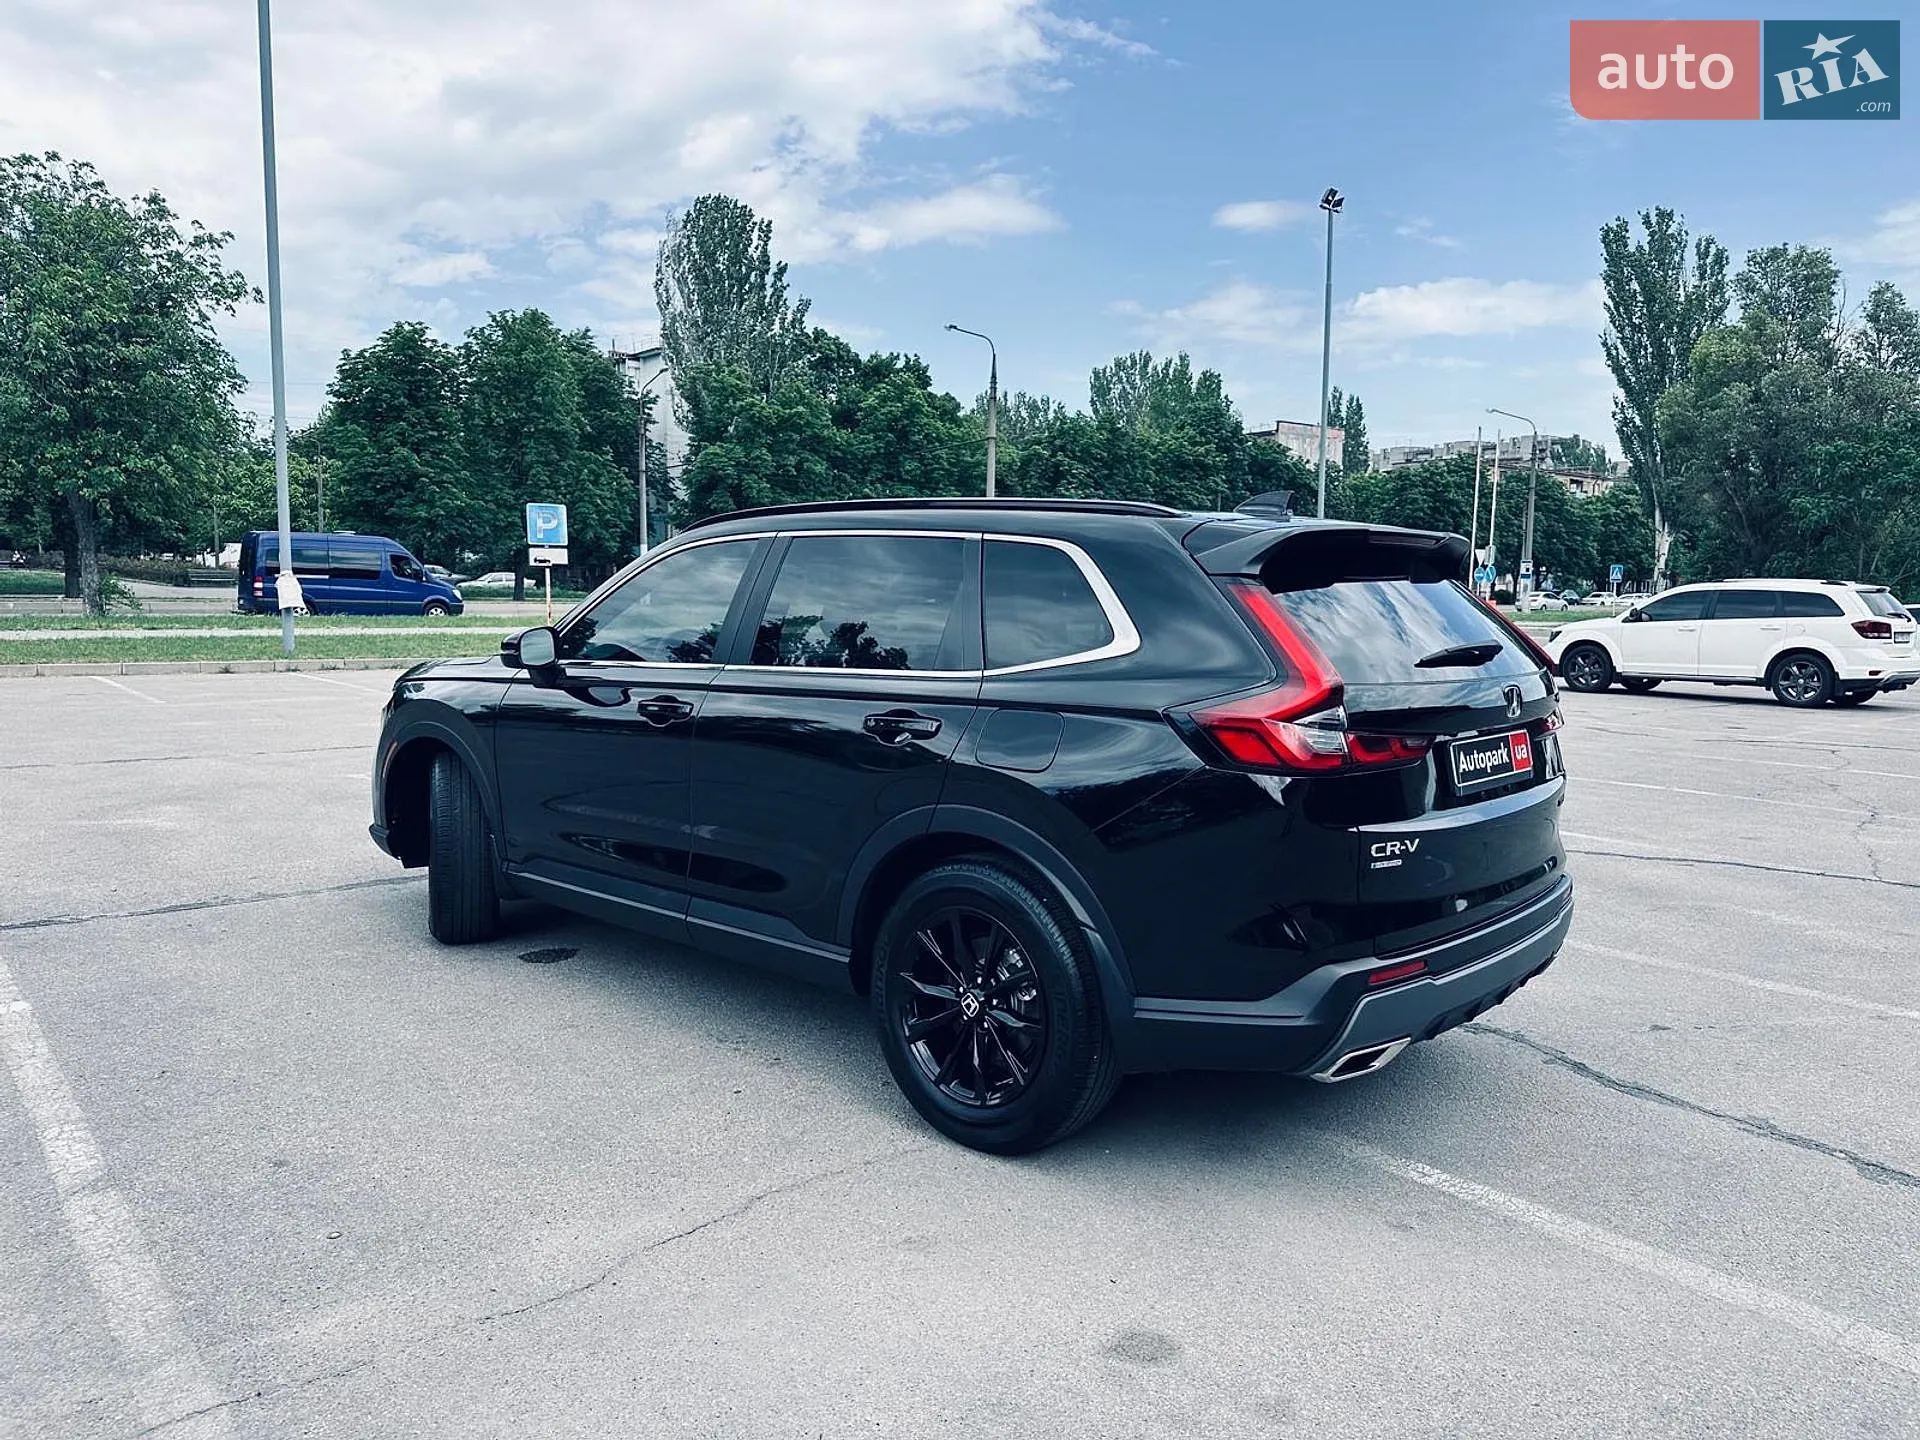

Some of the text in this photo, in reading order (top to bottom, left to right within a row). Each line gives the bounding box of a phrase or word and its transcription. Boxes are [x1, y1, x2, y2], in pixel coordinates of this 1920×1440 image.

[536, 511, 558, 539] P
[1459, 742, 1528, 773] Autopark ua
[1370, 838, 1420, 857] CR-V
